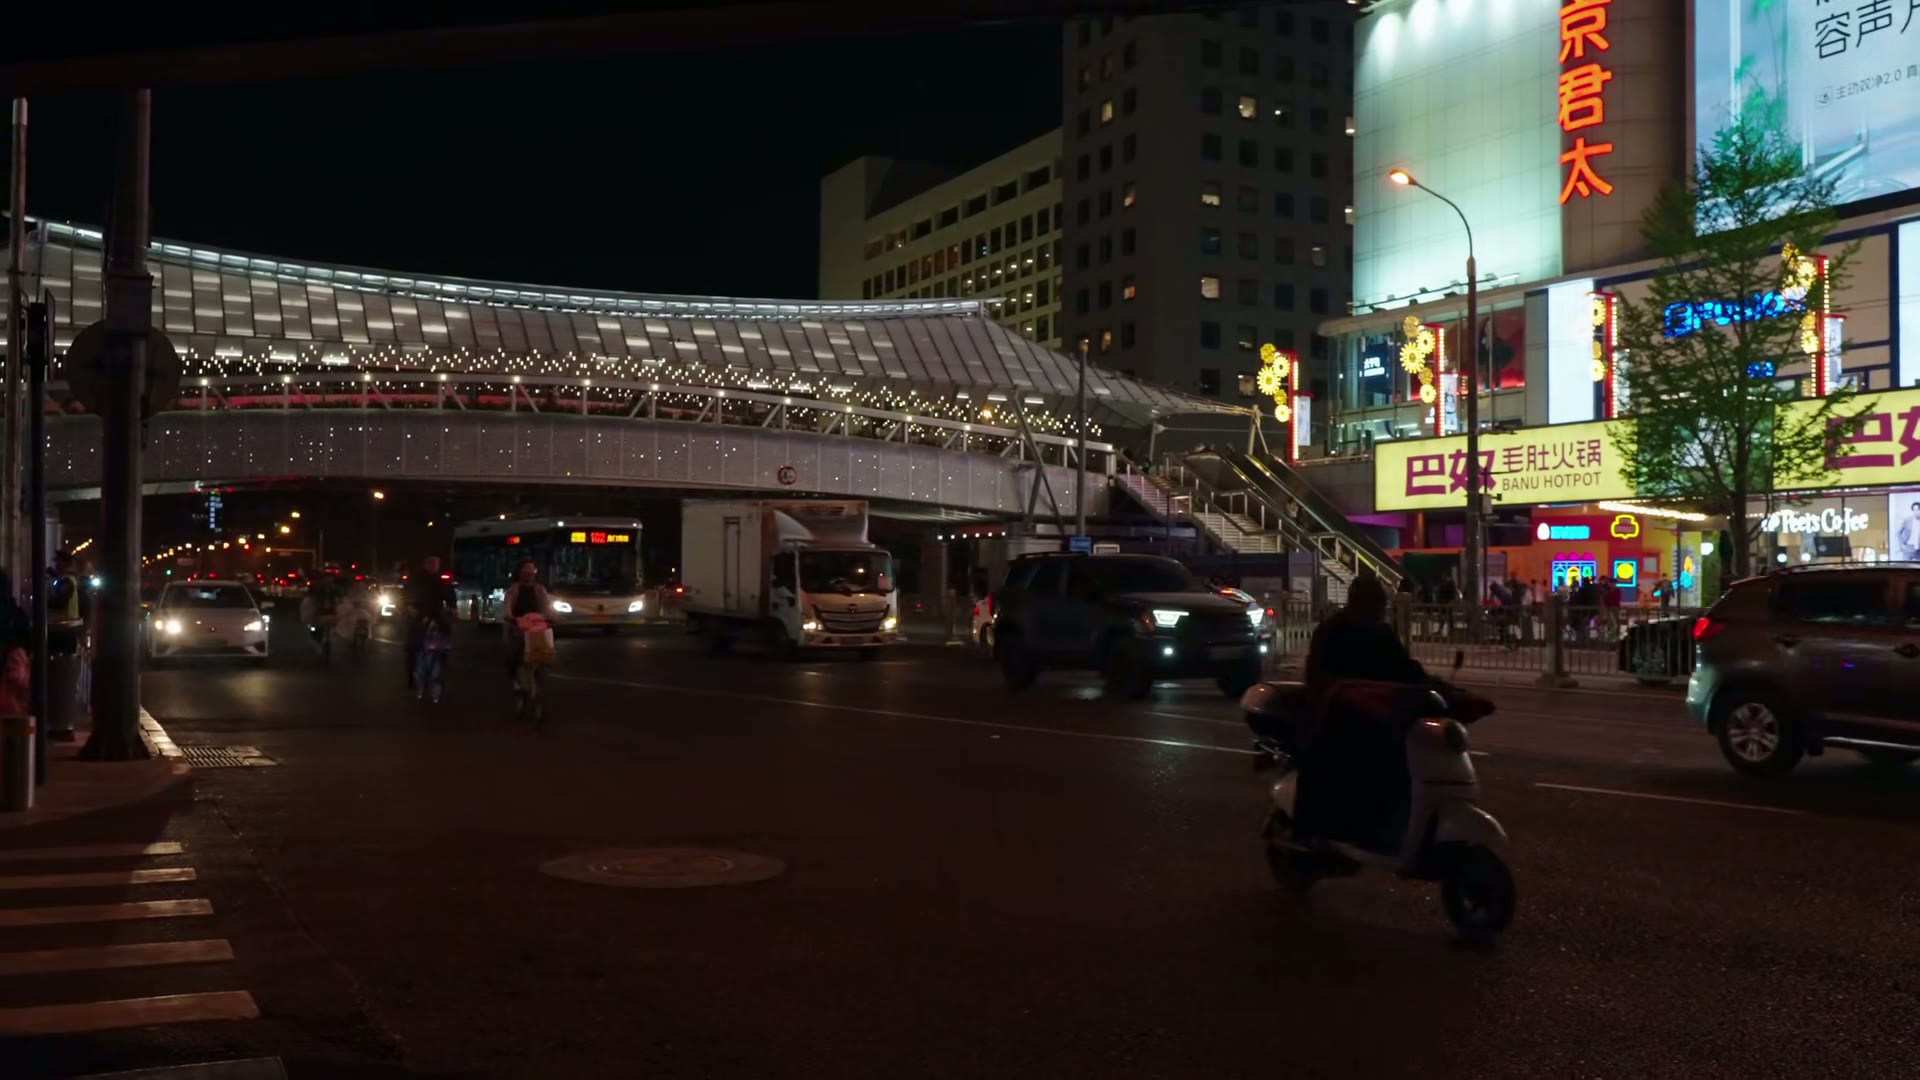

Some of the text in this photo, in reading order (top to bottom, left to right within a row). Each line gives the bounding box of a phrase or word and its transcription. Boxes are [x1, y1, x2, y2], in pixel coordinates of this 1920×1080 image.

[1558, 0, 1614, 206] 京君太
[1405, 438, 1601, 497] 巴奴 毛肚火锅
[1502, 471, 1602, 492] BANU HOTPOT
[1821, 507, 1869, 535] Cofee
